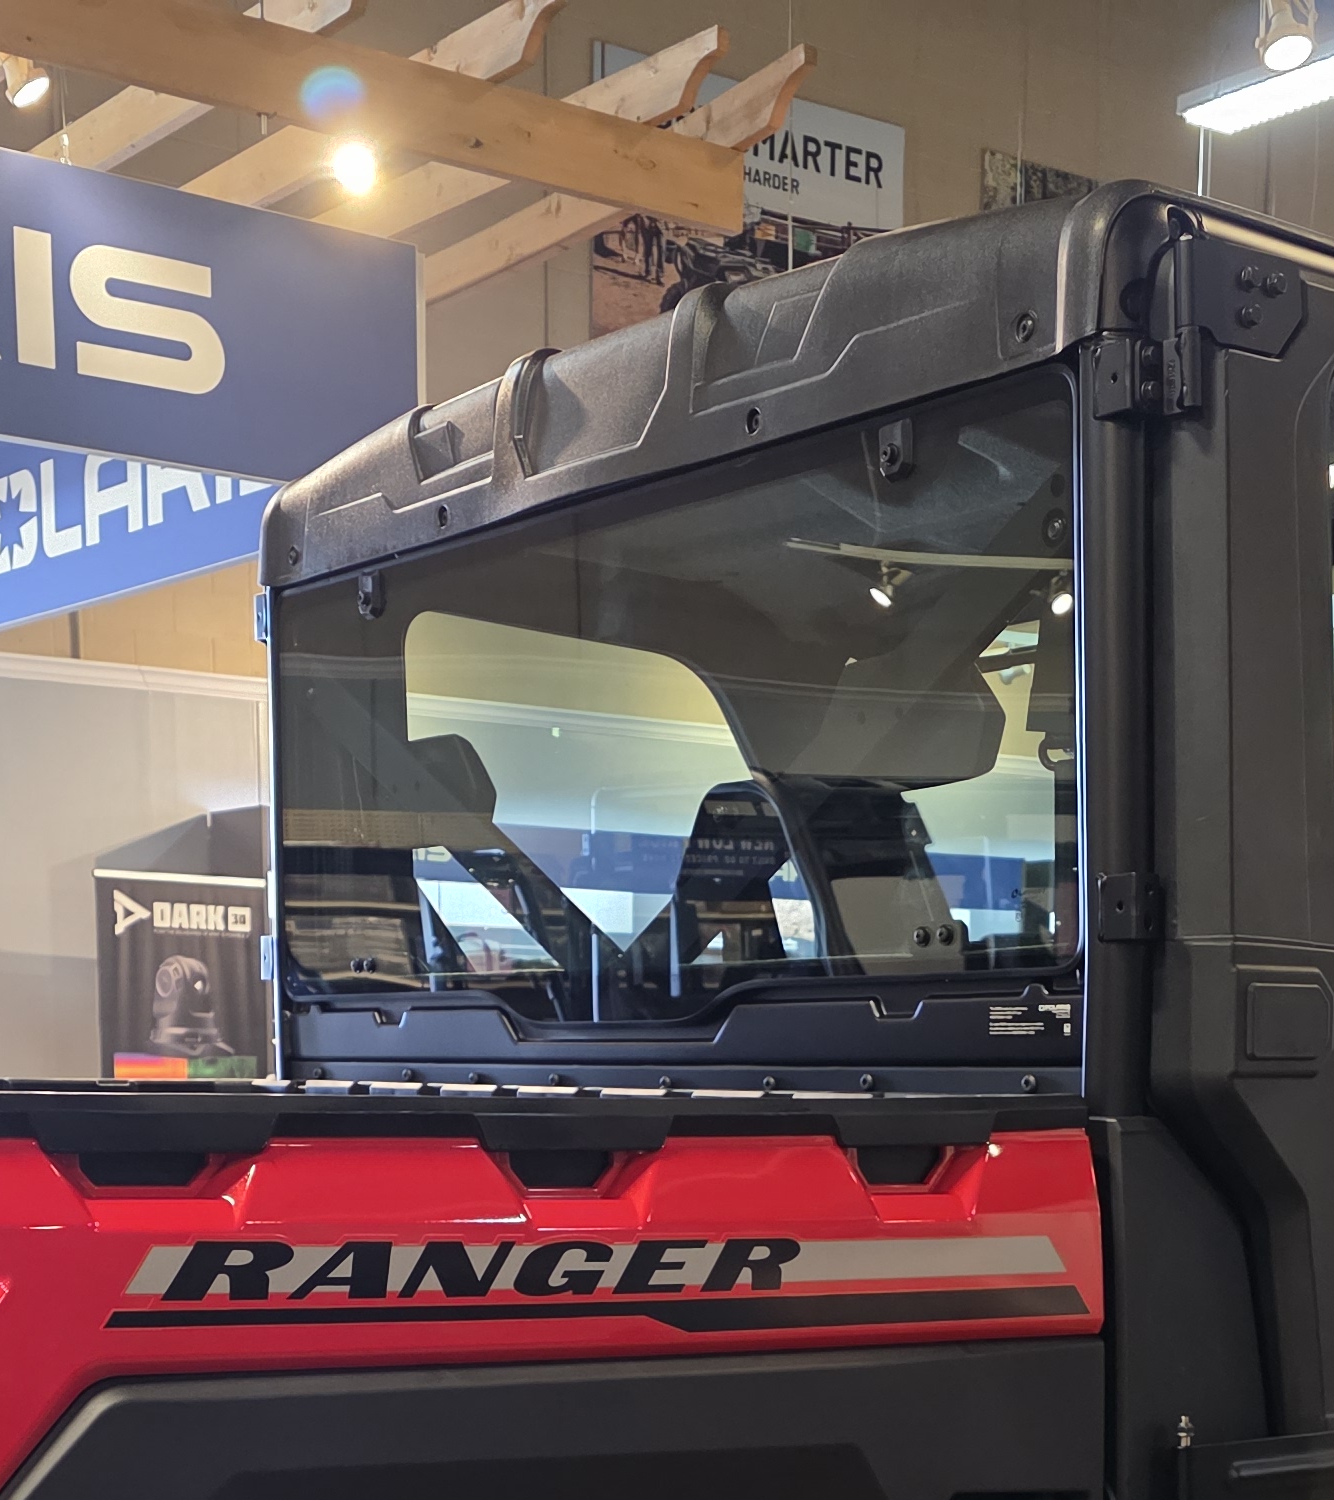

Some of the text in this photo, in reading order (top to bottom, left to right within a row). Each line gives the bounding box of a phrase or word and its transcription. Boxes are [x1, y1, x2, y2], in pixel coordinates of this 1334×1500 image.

[744, 165, 800, 195] HARDER
[746, 129, 883, 189] MARTER
[153, 901, 225, 931] DARK
[161, 1240, 800, 1300] RANGER
